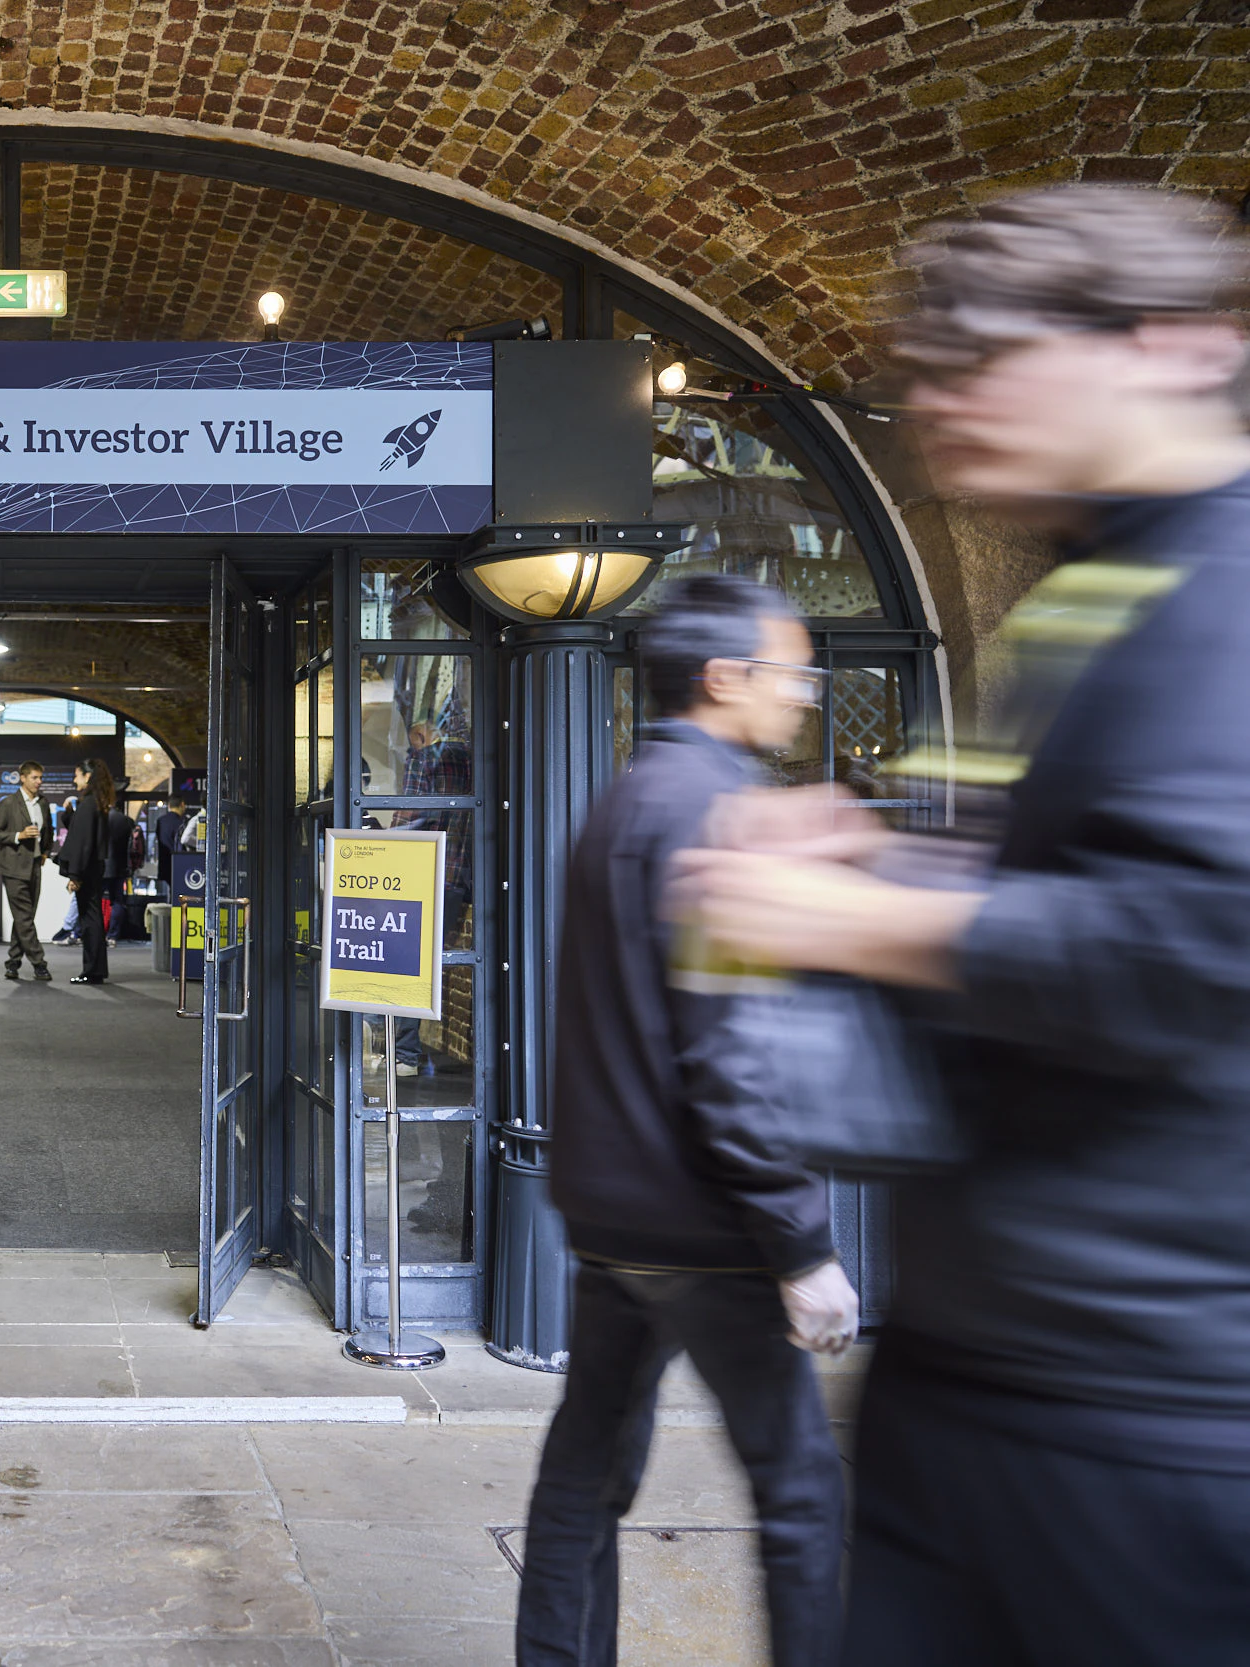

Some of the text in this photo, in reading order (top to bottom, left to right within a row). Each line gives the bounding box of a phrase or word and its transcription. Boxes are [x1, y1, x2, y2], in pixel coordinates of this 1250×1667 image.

[23, 420, 190, 454] Investor
[201, 420, 343, 462] Village
[339, 874, 401, 891] STOP 02
[336, 908, 407, 933] The AI
[335, 937, 385, 962] Trail
